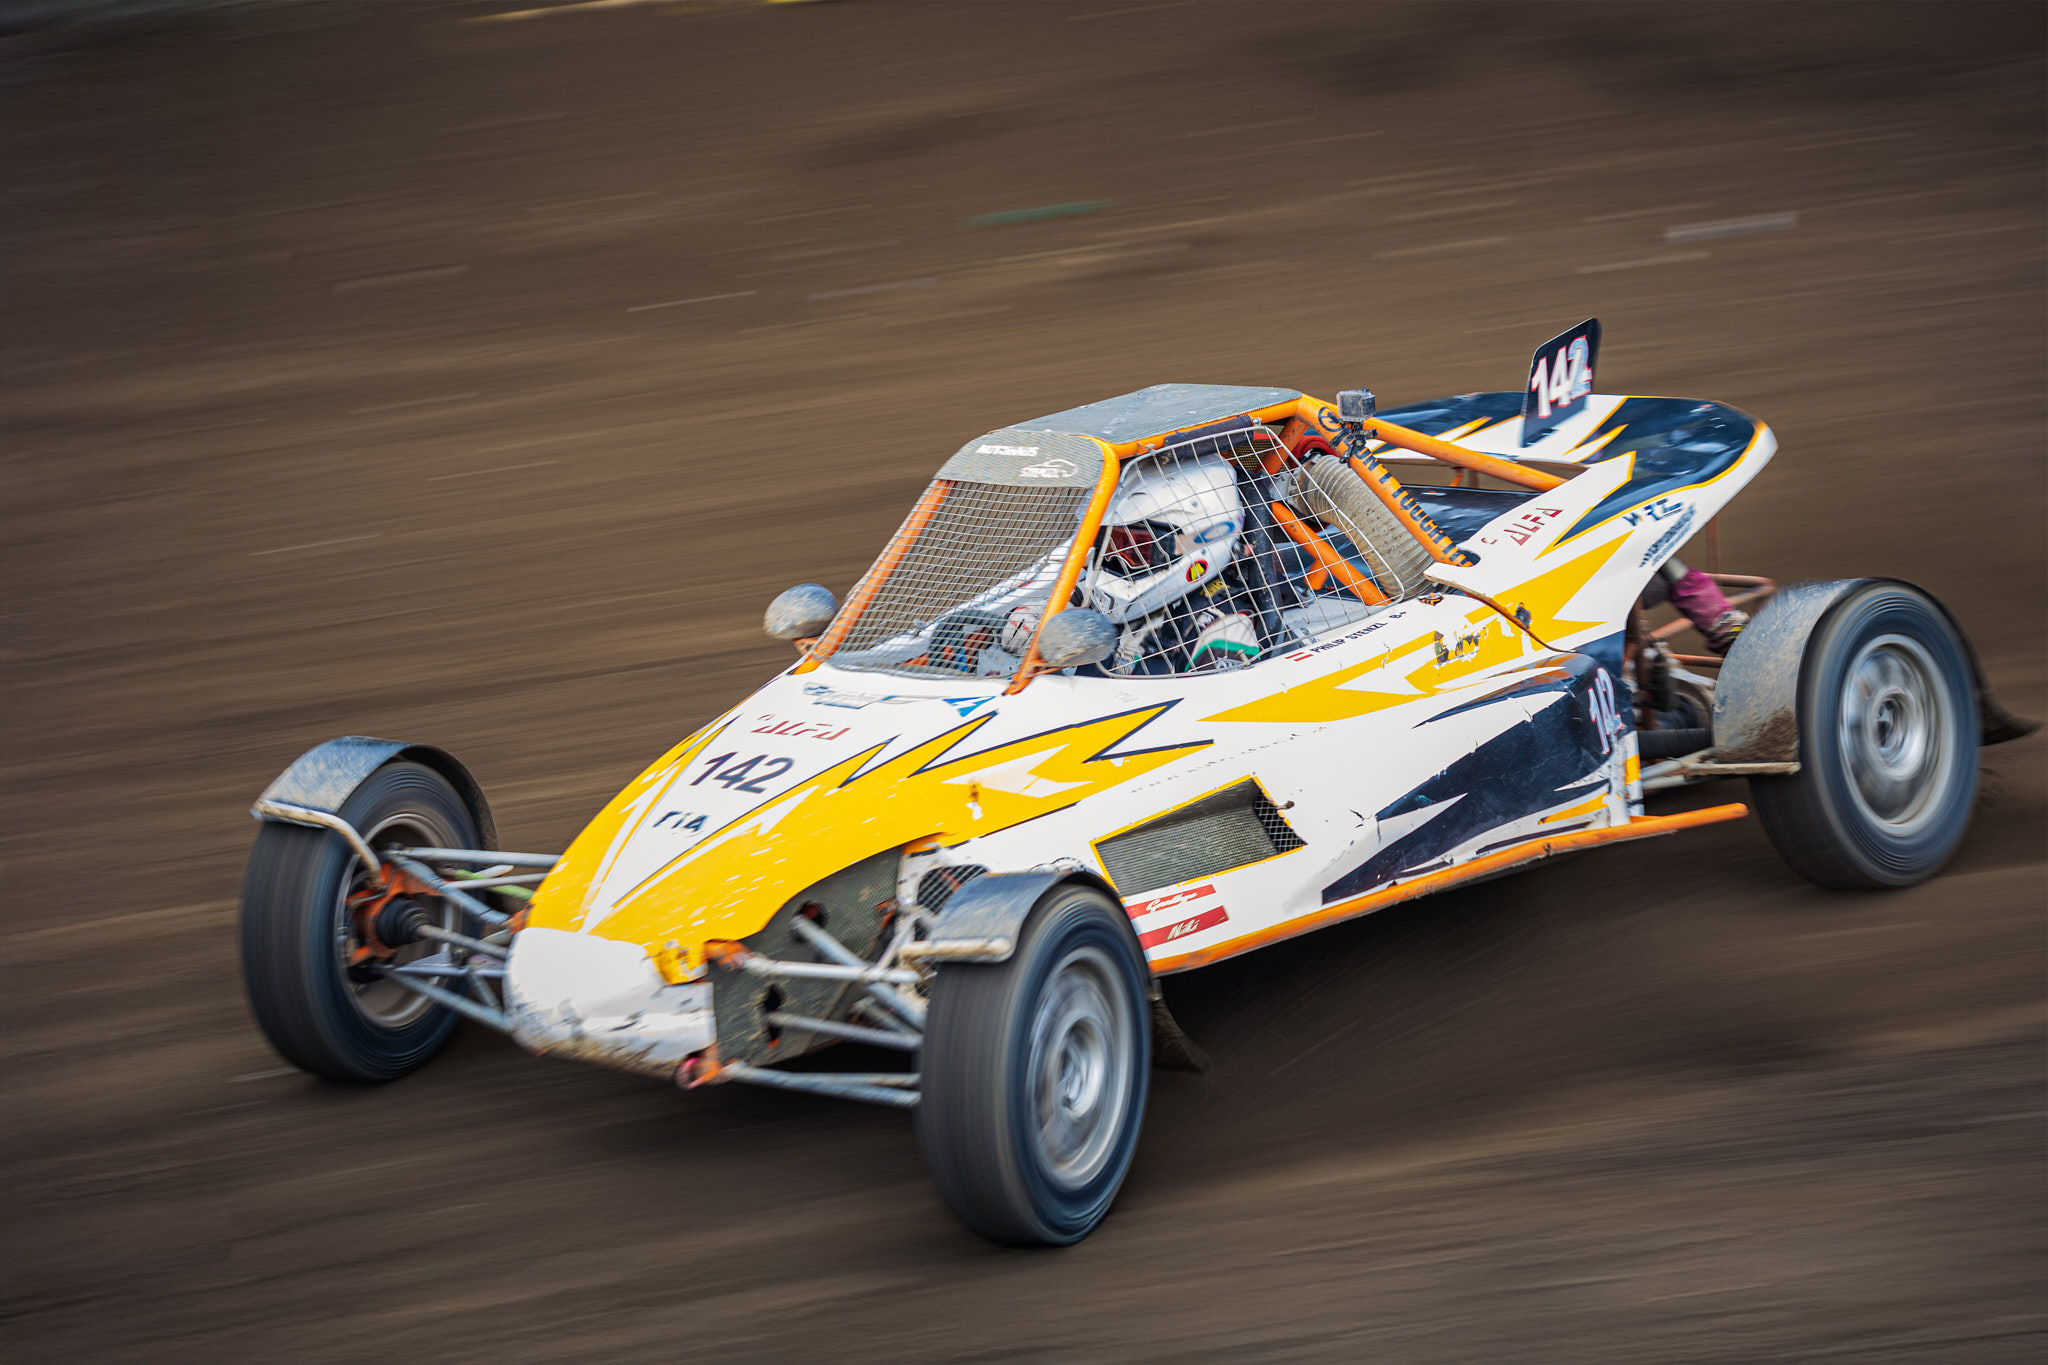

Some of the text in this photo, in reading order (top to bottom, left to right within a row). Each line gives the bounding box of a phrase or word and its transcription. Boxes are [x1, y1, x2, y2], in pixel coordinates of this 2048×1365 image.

[1531, 335, 1593, 419] 142
[1310, 638, 1347, 653] PHILIP
[690, 751, 794, 794] 142
